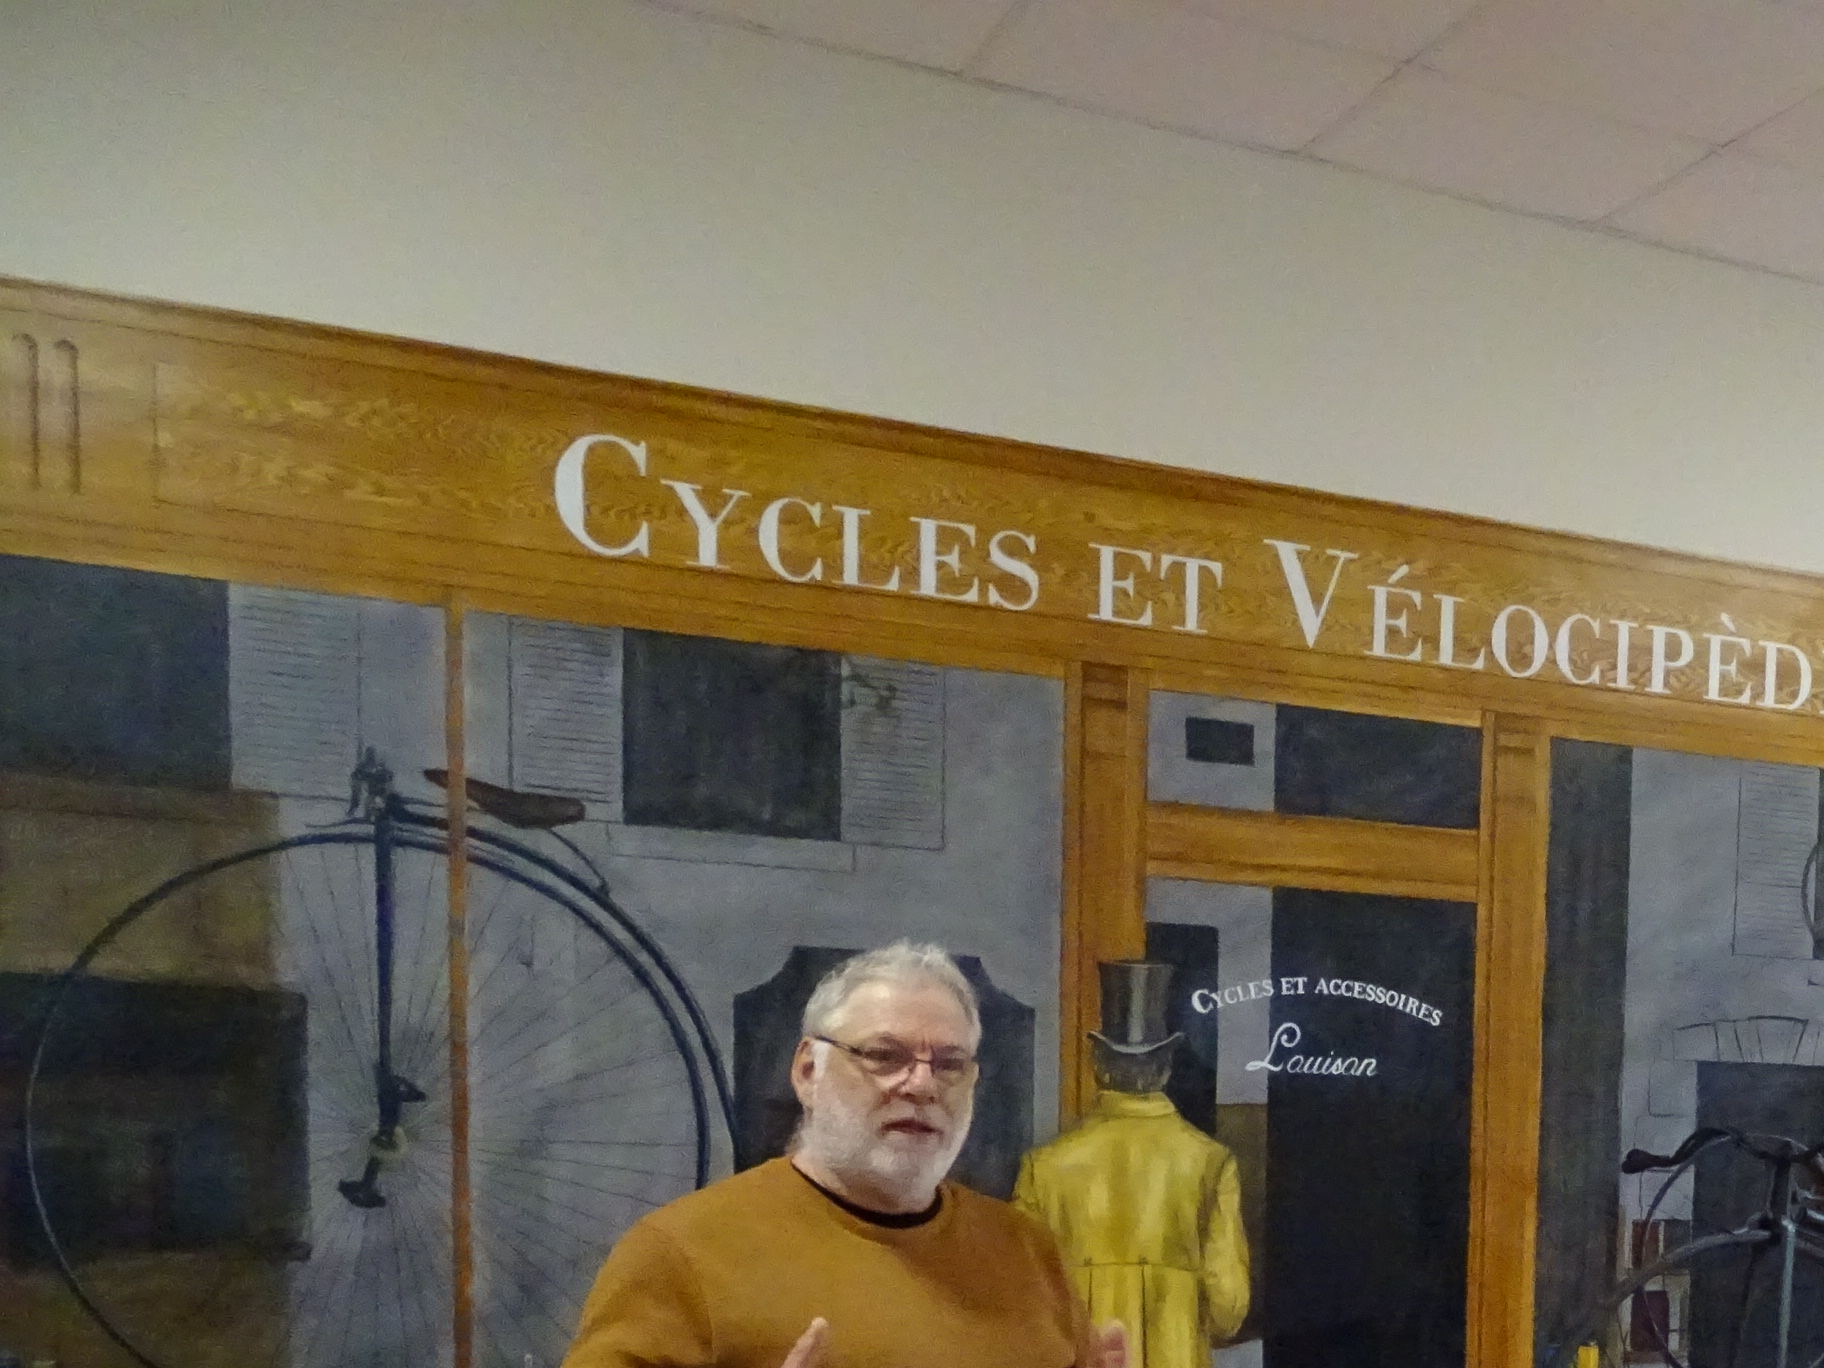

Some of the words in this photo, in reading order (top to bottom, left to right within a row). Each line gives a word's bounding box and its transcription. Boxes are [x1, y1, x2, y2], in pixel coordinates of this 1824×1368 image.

[553, 434, 1040, 610] CYCLES
[1087, 542, 1224, 635] ET
[1280, 976, 1308, 996] ET
[1314, 977, 1444, 1027] ACCESSOIRES
